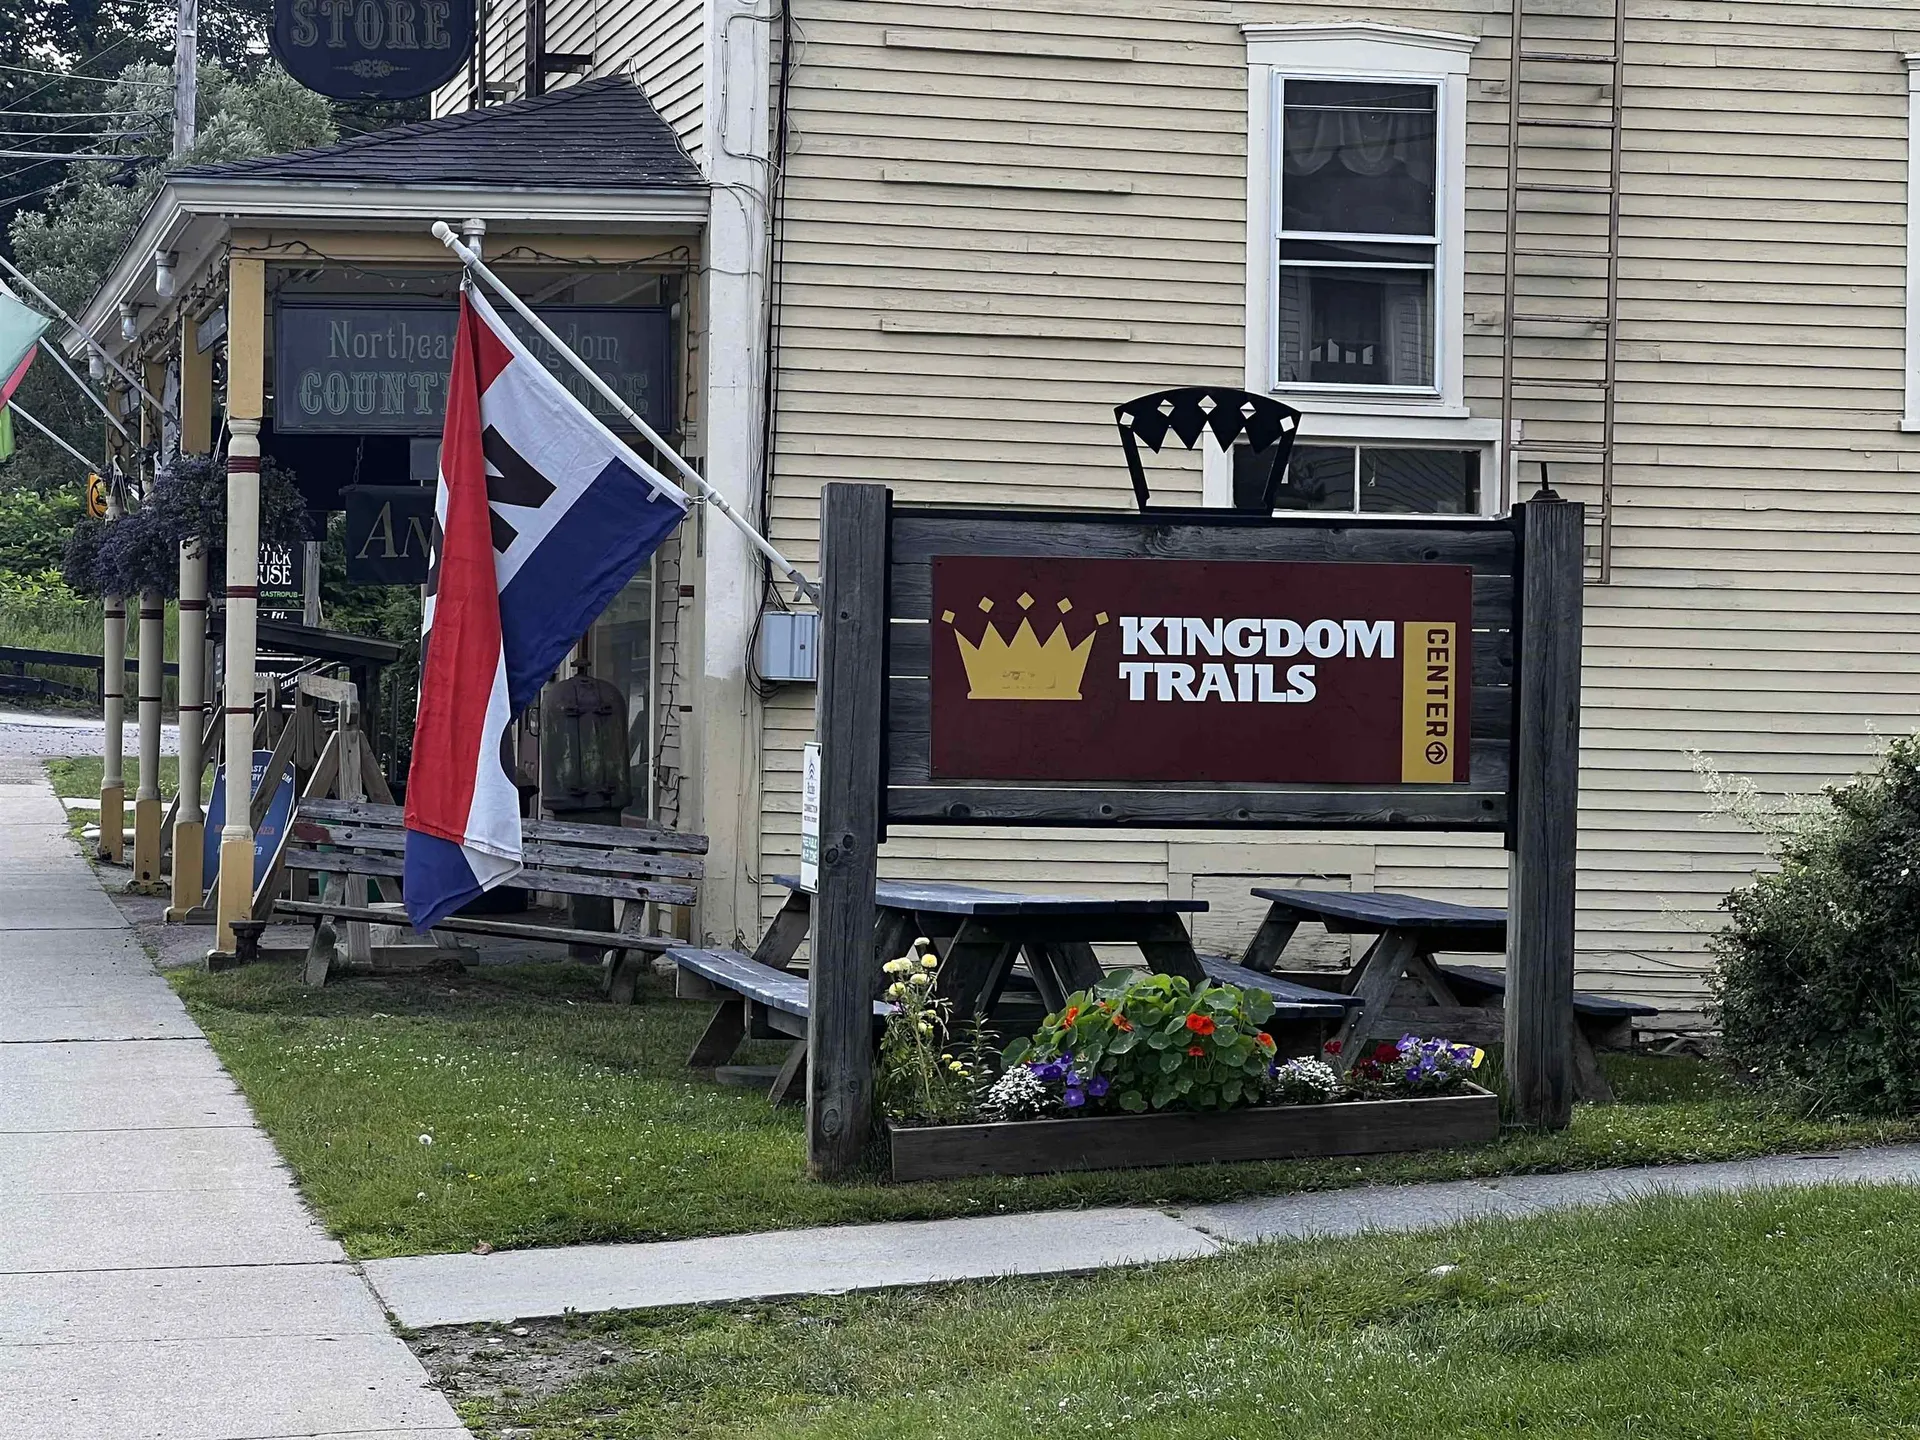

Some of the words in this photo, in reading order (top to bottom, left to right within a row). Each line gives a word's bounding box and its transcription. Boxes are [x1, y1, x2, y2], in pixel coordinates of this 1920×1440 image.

[291, 0, 451, 49] STORE
[328, 320, 456, 362] Northea
[258, 565, 292, 585] USE
[1119, 616, 1395, 658] KINGDOM
[1119, 662, 1317, 703] TRAILS
[1425, 628, 1449, 737] CENTER
